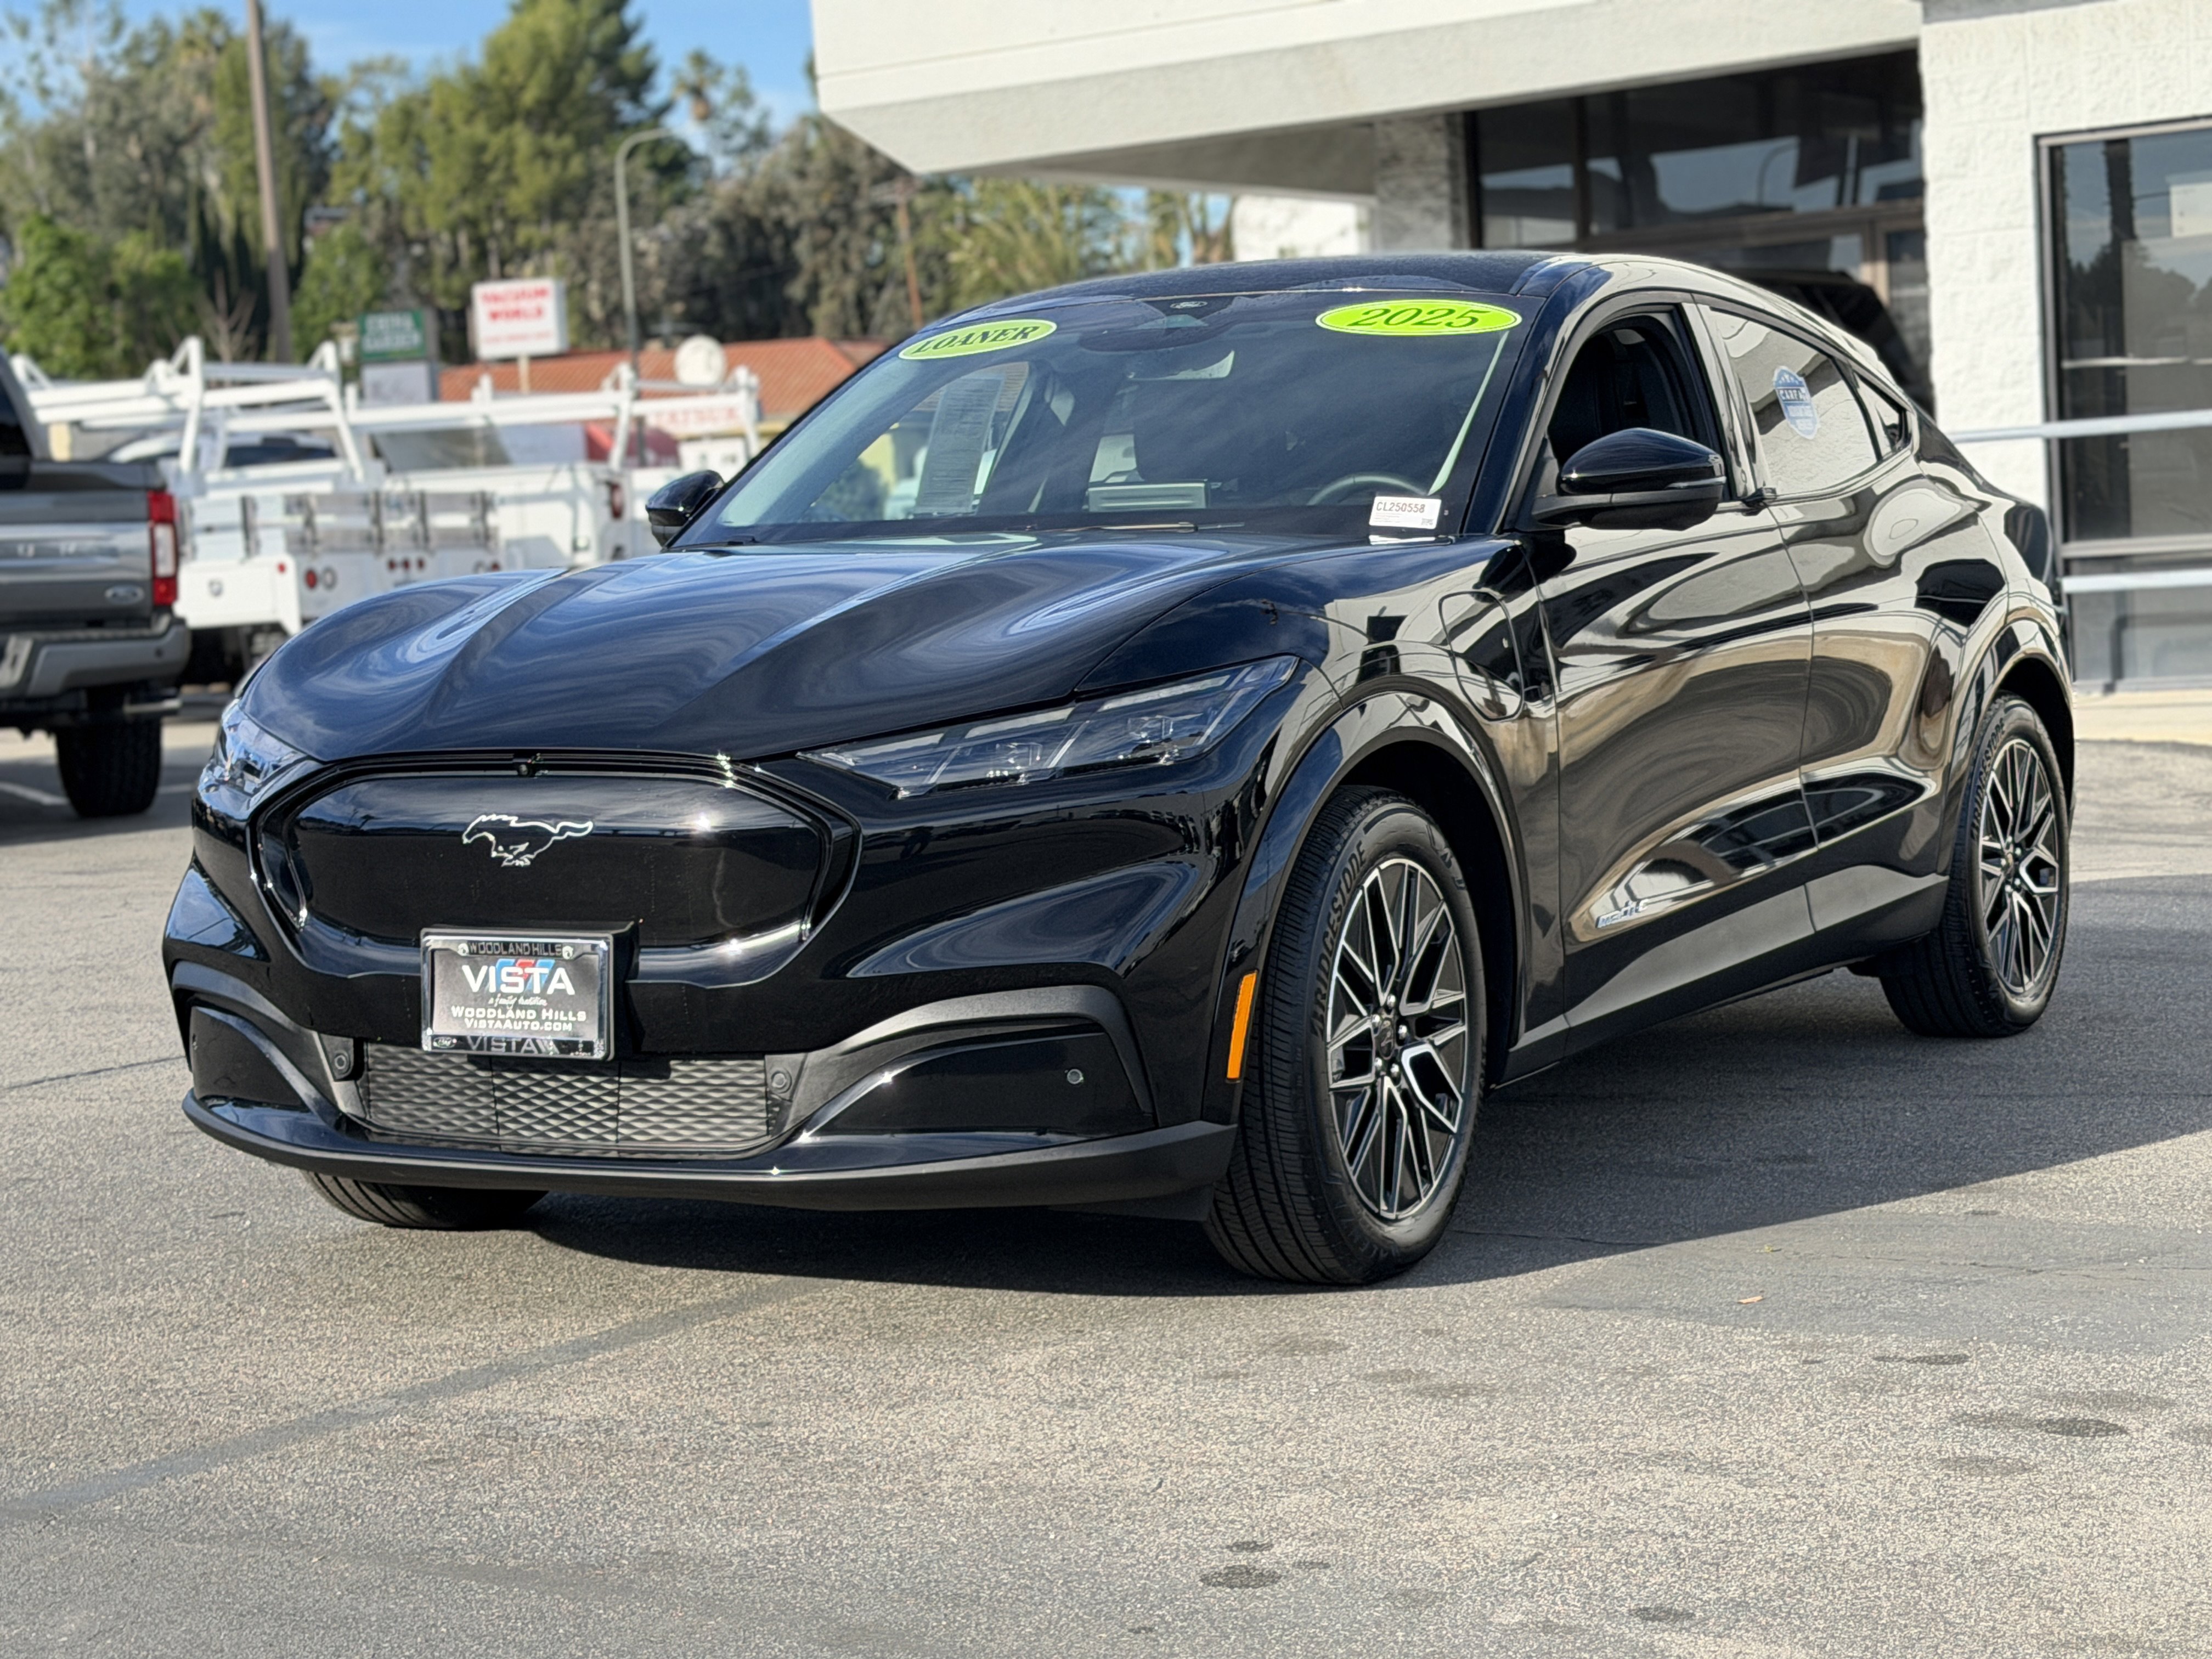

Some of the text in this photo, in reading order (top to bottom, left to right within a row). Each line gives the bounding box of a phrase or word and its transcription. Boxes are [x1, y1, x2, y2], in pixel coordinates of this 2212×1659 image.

[1347, 308, 1491, 328] 2025
[911, 326, 1041, 354] LOANER
[1376, 501, 1425, 514] CL250558
[1311, 840, 1366, 1037] BRIDGESTONE
[469, 941, 562, 957] WOODLAND HILLS
[462, 964, 575, 995] VISTA
[451, 1006, 586, 1022] WOODLAND HILLS
[466, 1035, 535, 1055] VISTA
